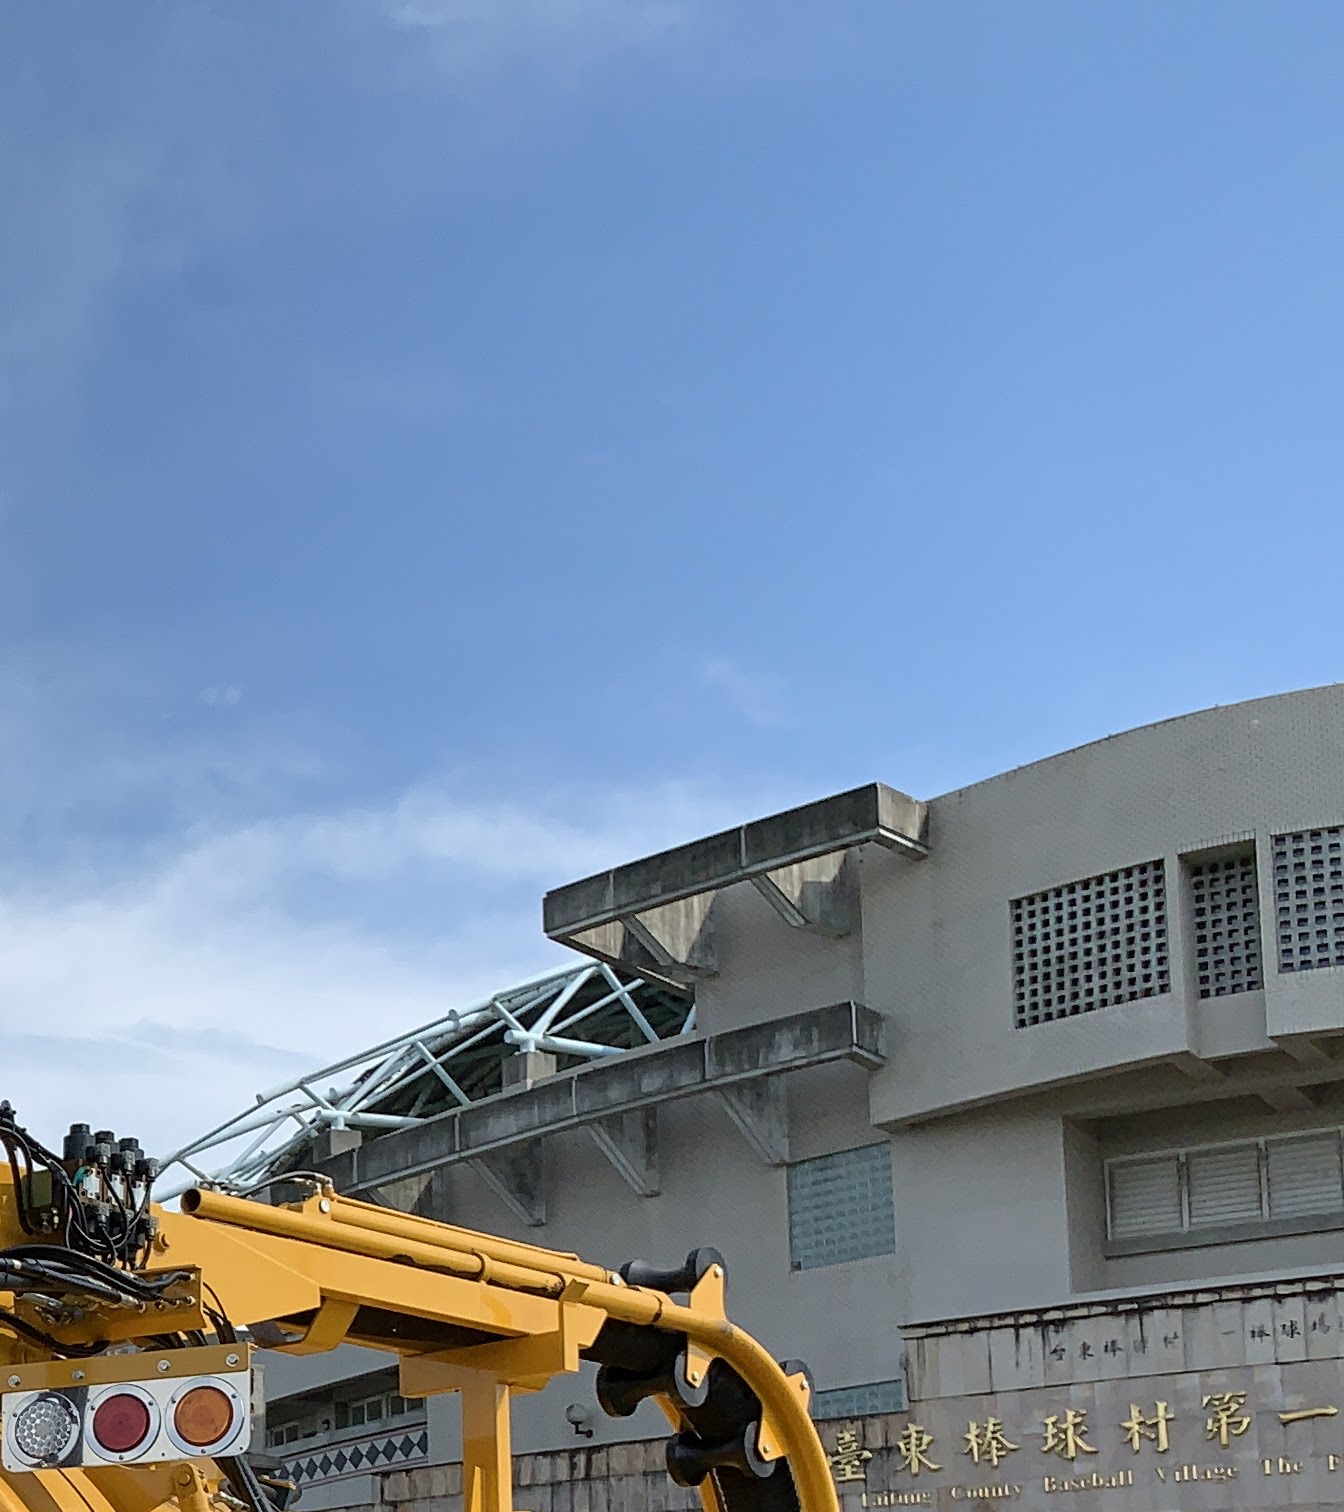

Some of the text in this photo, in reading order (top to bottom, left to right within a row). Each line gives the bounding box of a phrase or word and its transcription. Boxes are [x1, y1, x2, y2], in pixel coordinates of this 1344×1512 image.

[827, 1390, 1340, 1483] 臺東棒球村第一
[950, 1482, 1023, 1501] County
[1043, 1468, 1134, 1493] Baseball
[1156, 1462, 1239, 1483] Village
[1260, 1456, 1304, 1476] The
